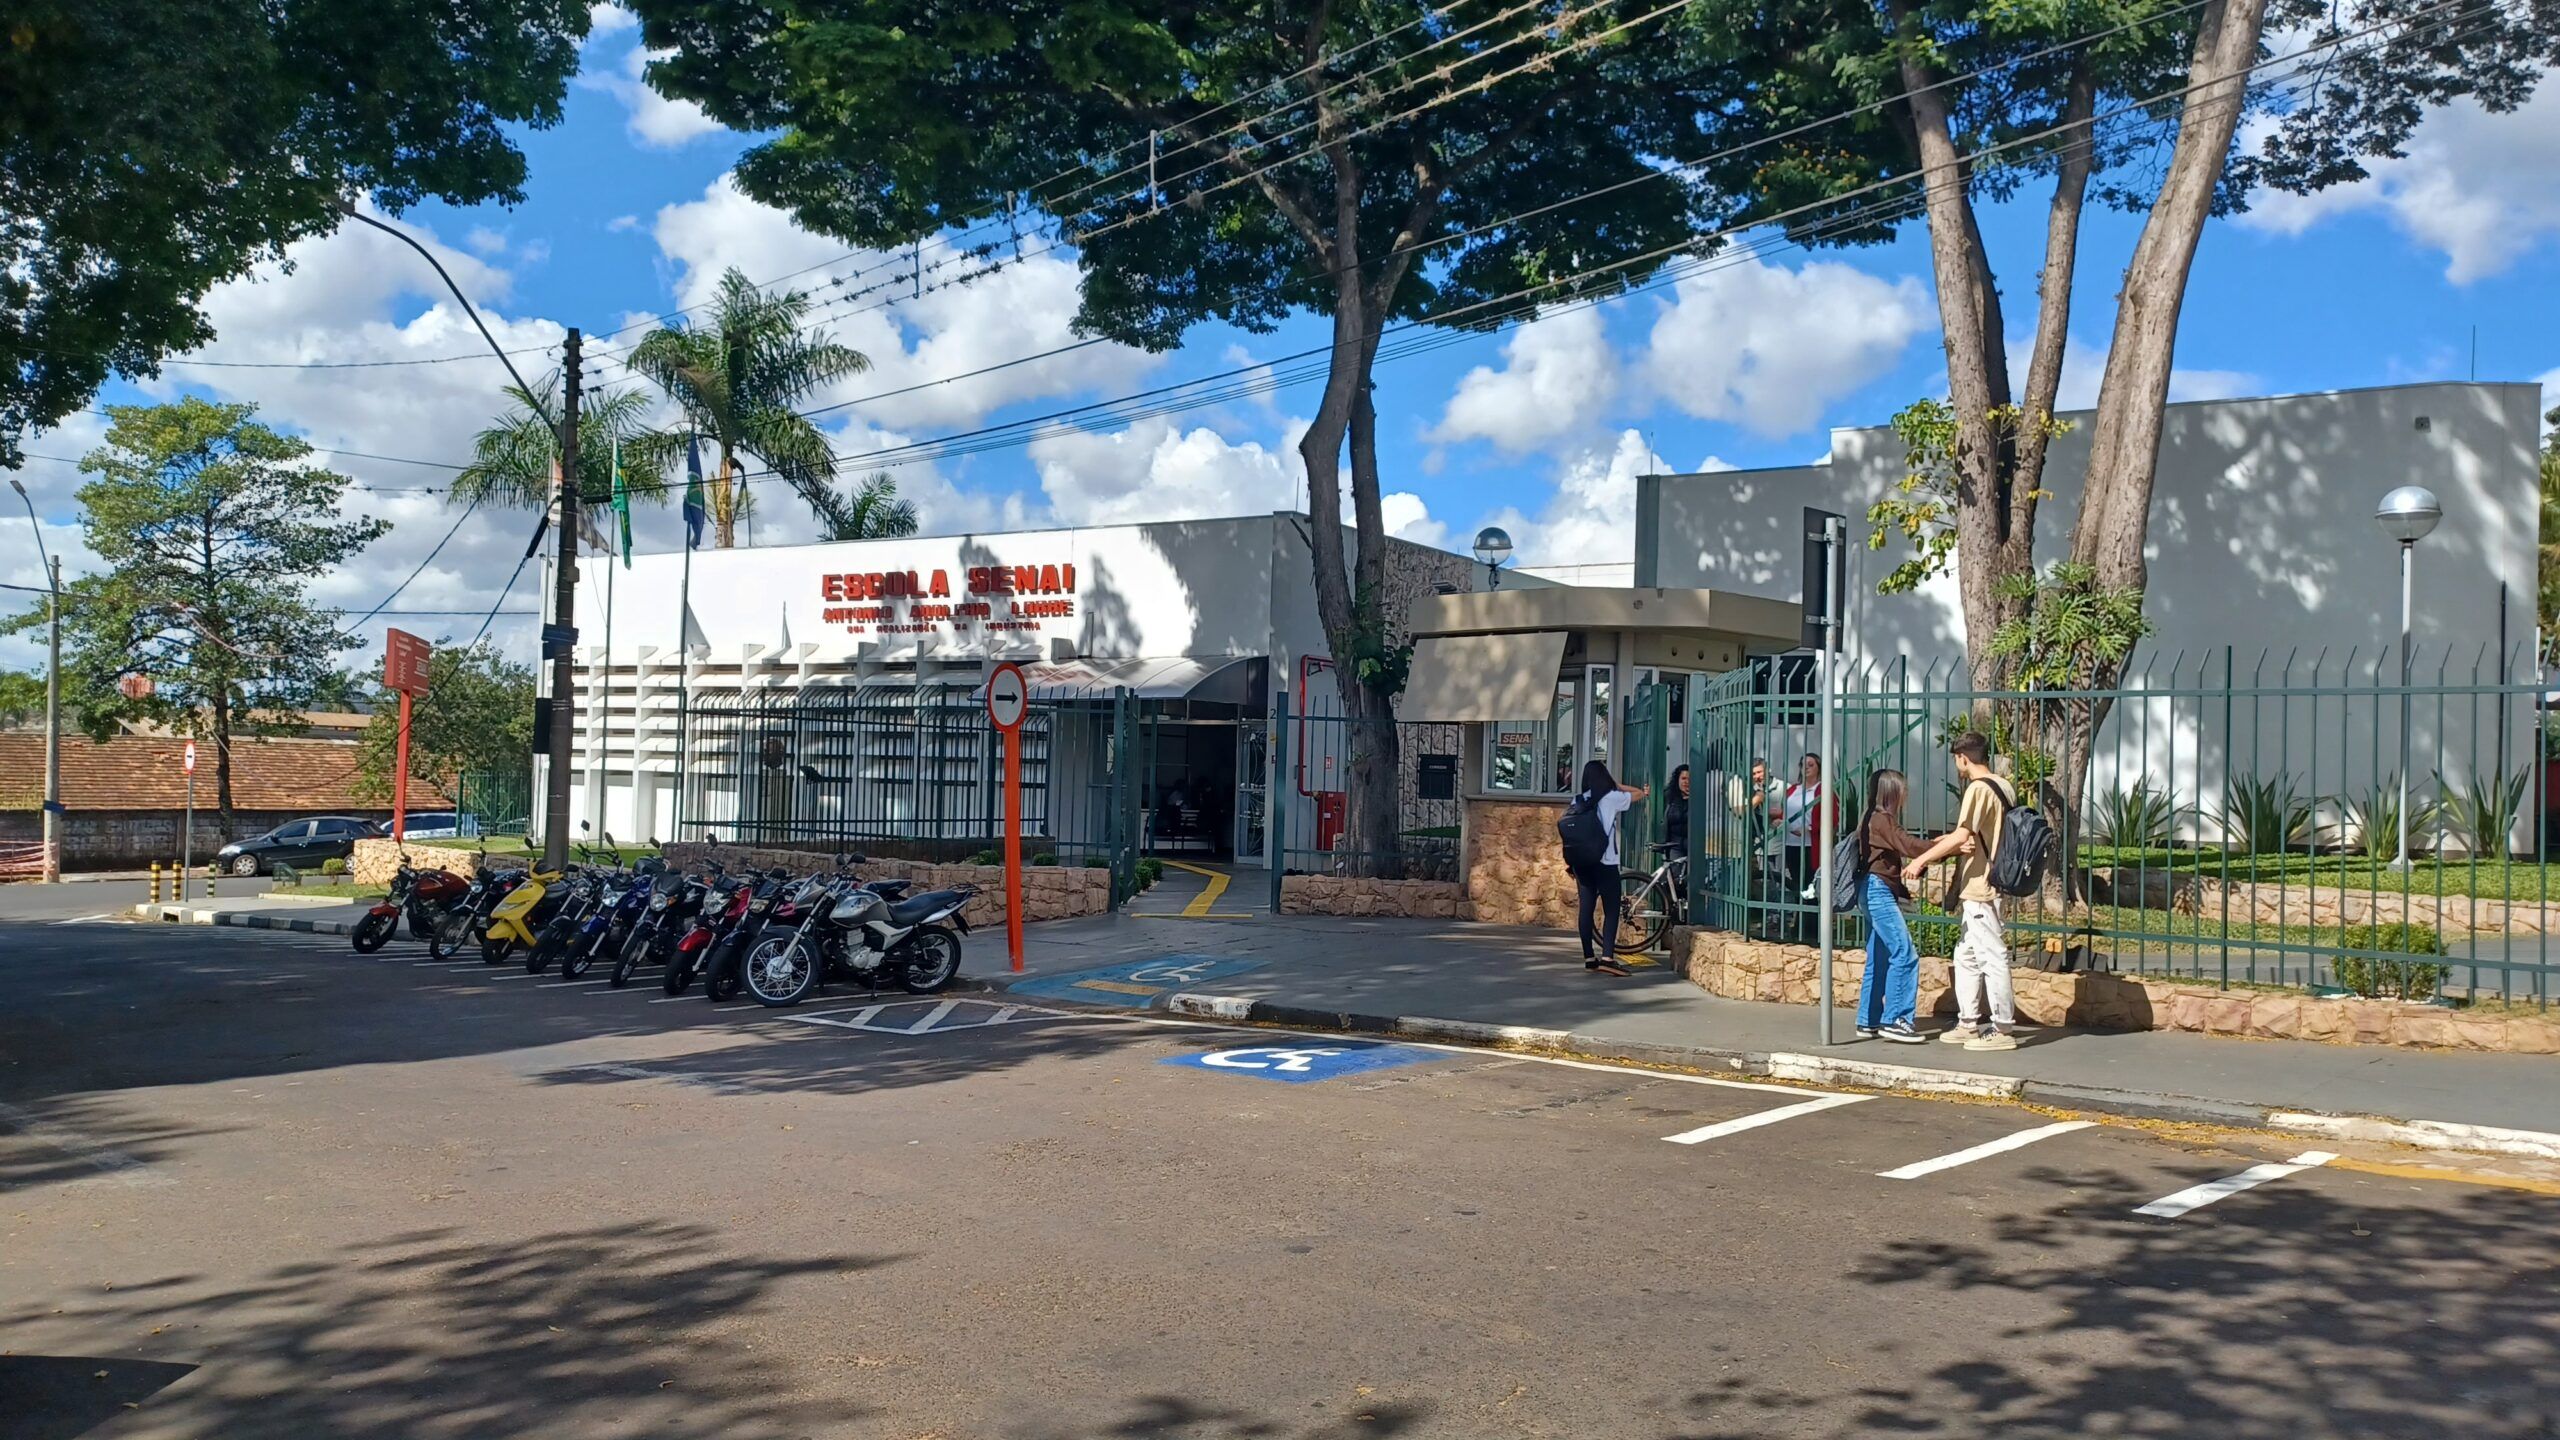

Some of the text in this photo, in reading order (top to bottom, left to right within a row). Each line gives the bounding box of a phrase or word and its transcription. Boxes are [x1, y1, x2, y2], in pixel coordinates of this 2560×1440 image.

[822, 563, 1076, 601] ESCOLA SENAI
[822, 606, 895, 624] ANTONIO
